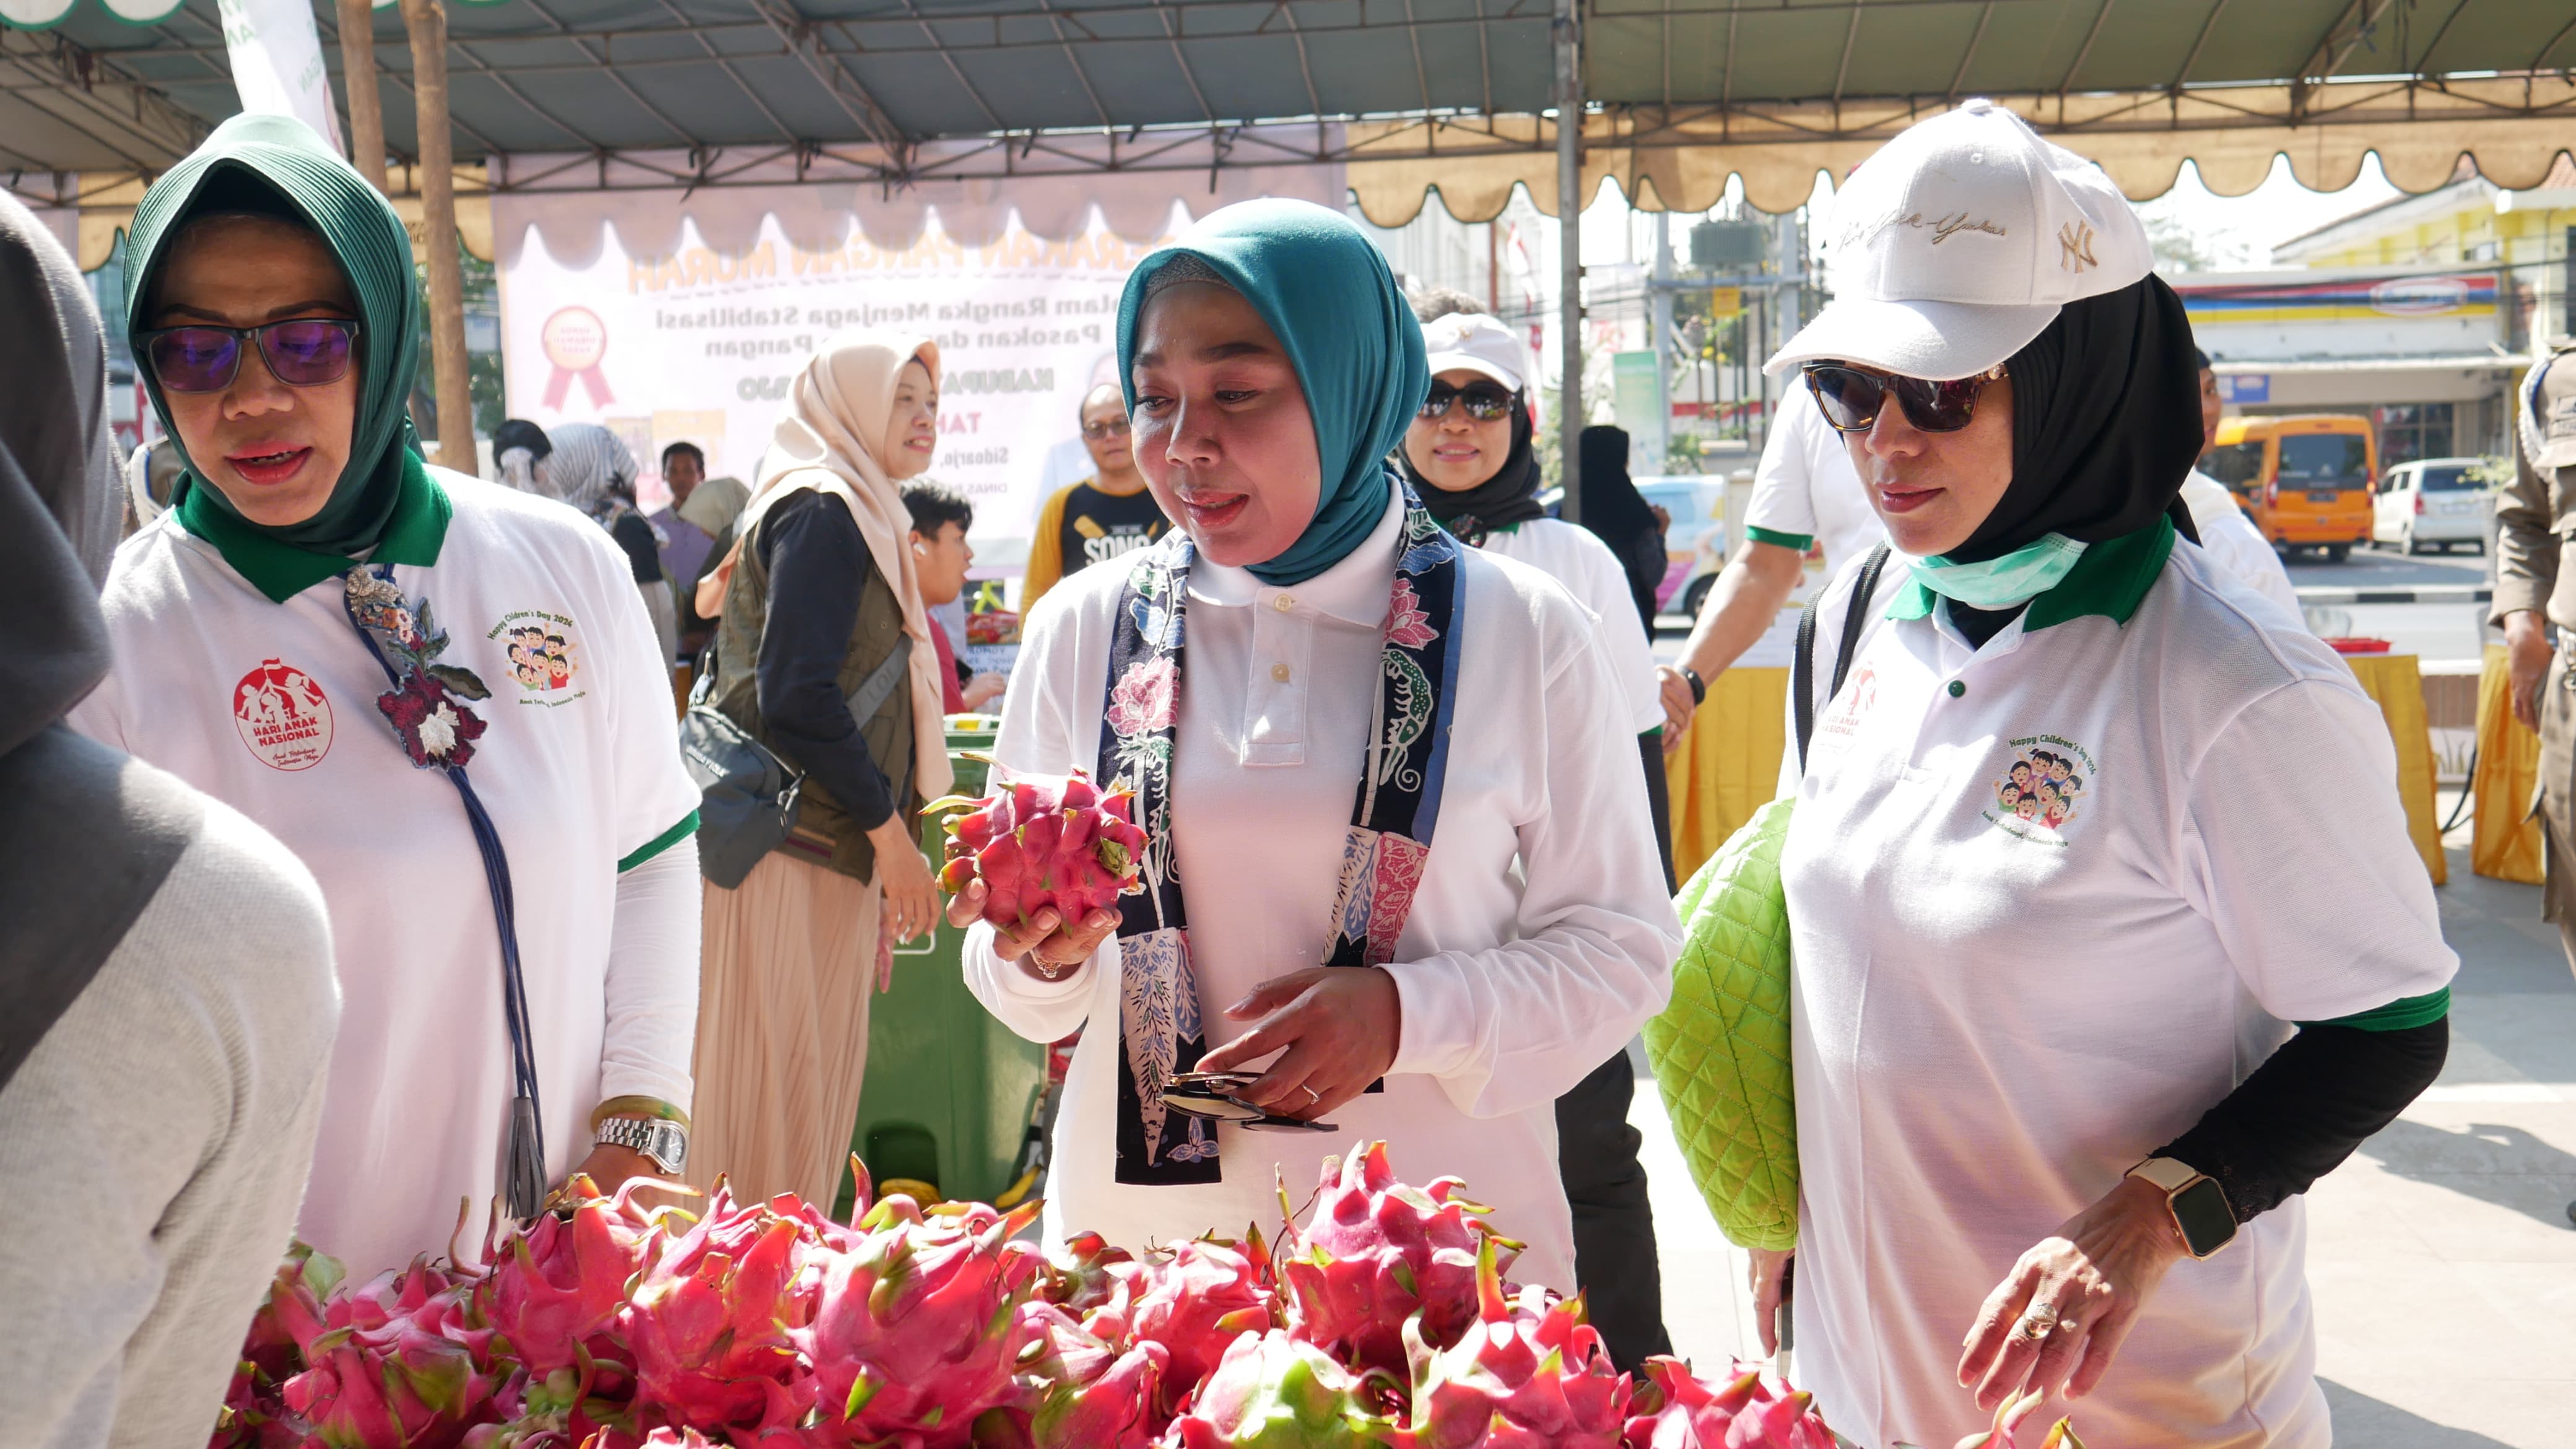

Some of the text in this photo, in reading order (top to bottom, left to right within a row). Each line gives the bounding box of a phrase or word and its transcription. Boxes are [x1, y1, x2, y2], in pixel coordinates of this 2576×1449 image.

[2056, 218, 2099, 274] NY
[486, 621, 508, 641] Happy
[536, 610, 552, 621] Day
[553, 614, 574, 628] 2024
[252, 716, 318, 738] HARI ANAK
[258, 728, 320, 747] NASIONAL
[2008, 735, 2038, 749] Happy
[2039, 734, 2079, 752] Children's
